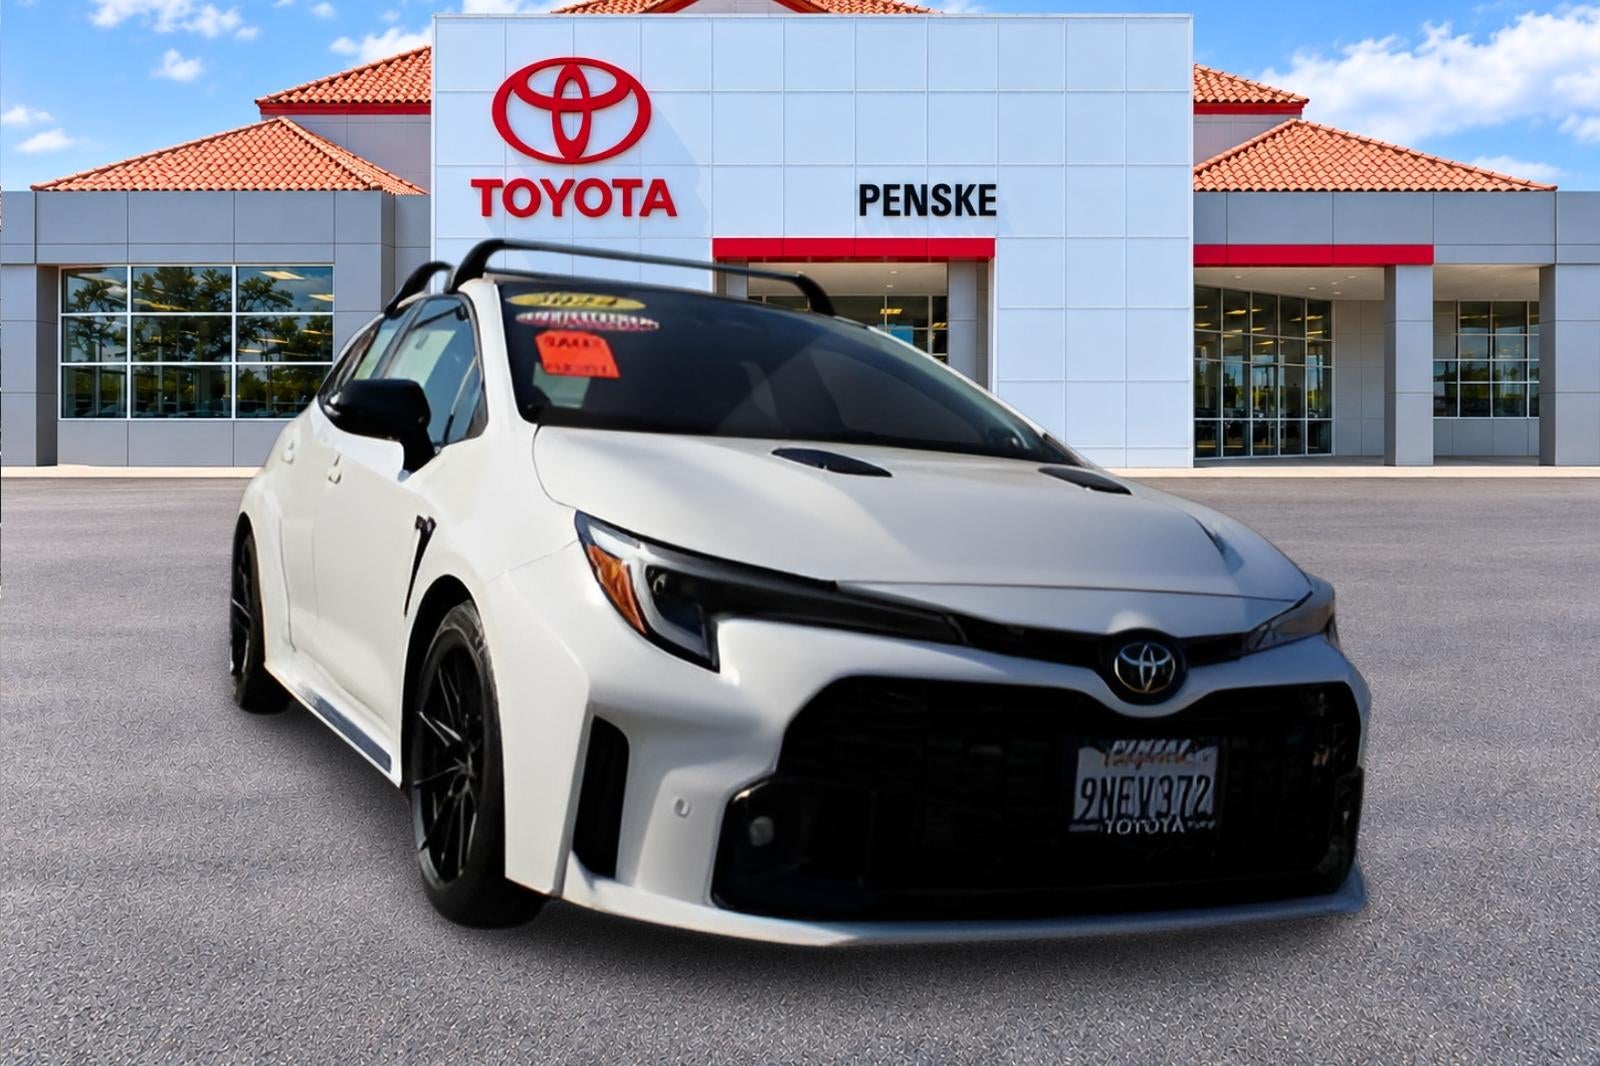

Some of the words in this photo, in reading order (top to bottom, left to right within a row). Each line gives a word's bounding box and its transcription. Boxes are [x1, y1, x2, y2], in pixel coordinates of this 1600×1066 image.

[470, 178, 677, 218] TOYOTA
[859, 183, 997, 217] PENSKE
[1079, 775, 1212, 822] 9NEV372
[1104, 816, 1186, 835] TOYOTA
